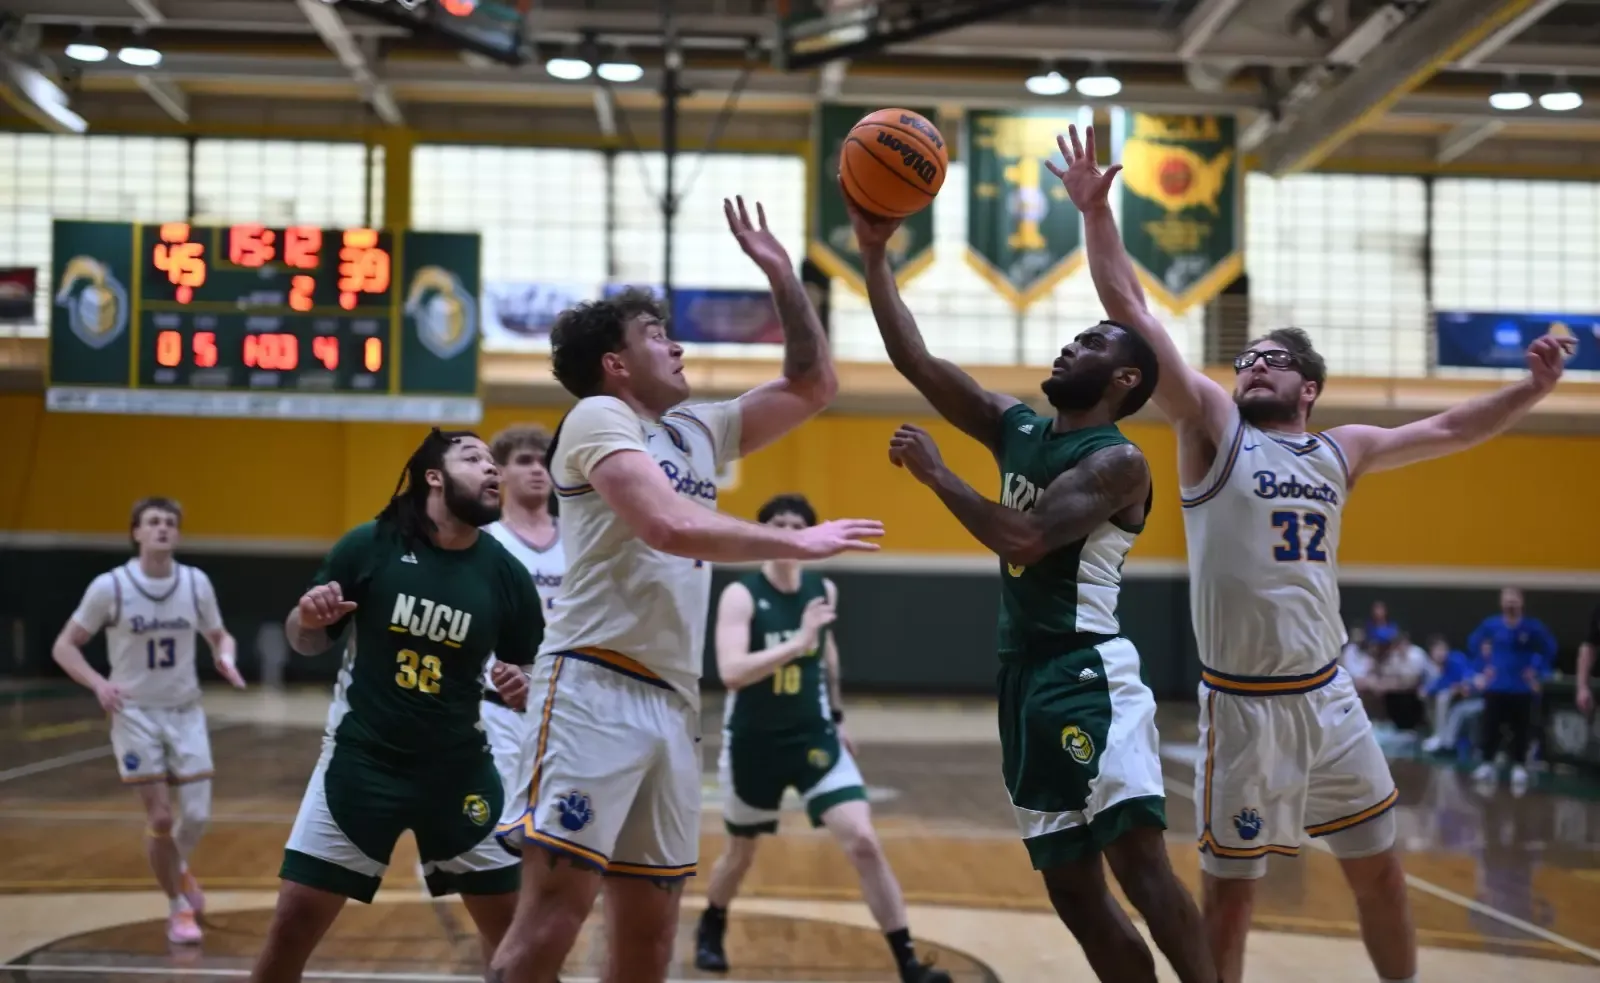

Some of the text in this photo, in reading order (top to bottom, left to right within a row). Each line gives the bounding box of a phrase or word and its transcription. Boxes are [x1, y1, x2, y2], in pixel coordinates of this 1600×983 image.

[877, 131, 937, 185] Wilson
[153, 243, 207, 288] 45
[192, 331, 219, 369] 5
[1252, 470, 1339, 506] Bobcats
[1271, 510, 1328, 562] 32
[390, 592, 473, 644] NJCU
[147, 638, 176, 671] 13
[394, 648, 443, 695] 32
